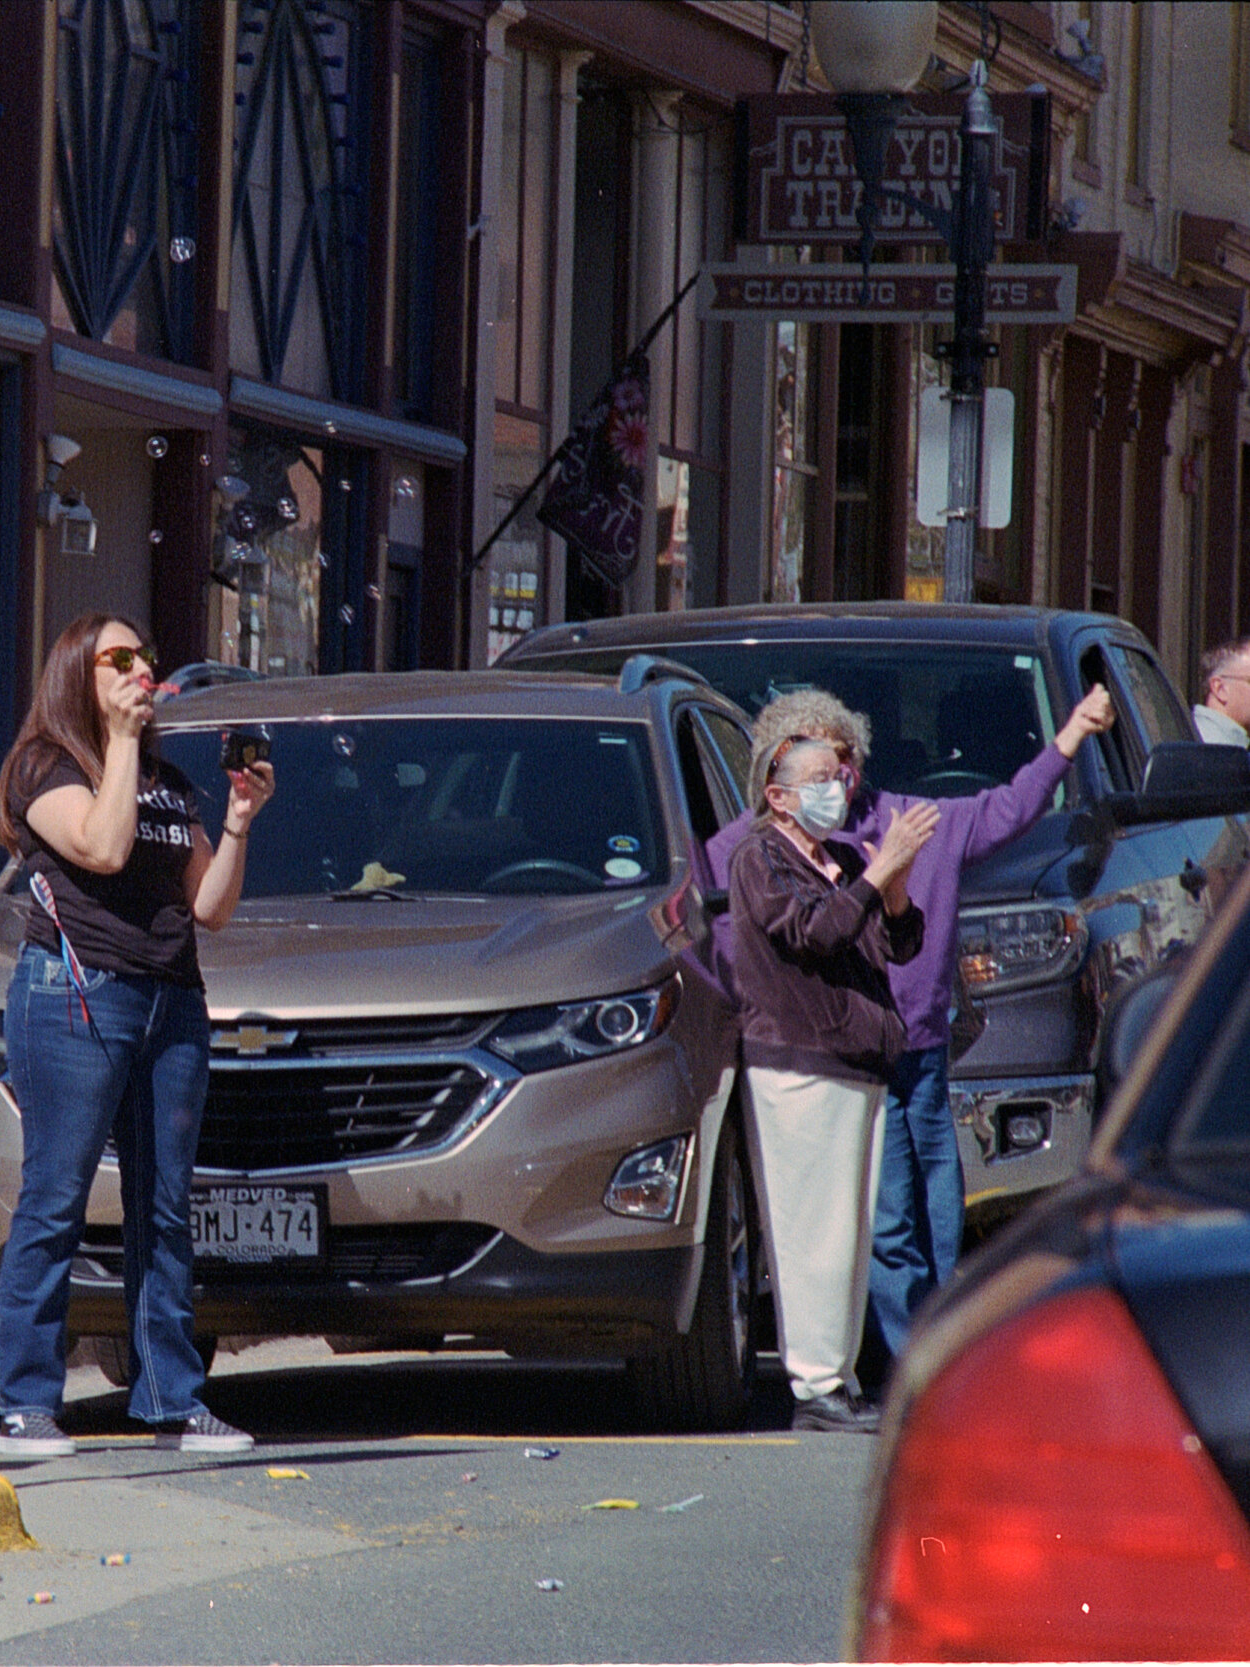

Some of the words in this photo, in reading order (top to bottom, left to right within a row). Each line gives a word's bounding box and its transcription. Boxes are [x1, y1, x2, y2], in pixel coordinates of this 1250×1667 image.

[791, 129, 963, 176] CAYO
[786, 180, 1002, 228] TRDIN
[935, 281, 1030, 303] GTS
[209, 1187, 288, 1202] MEDVED
